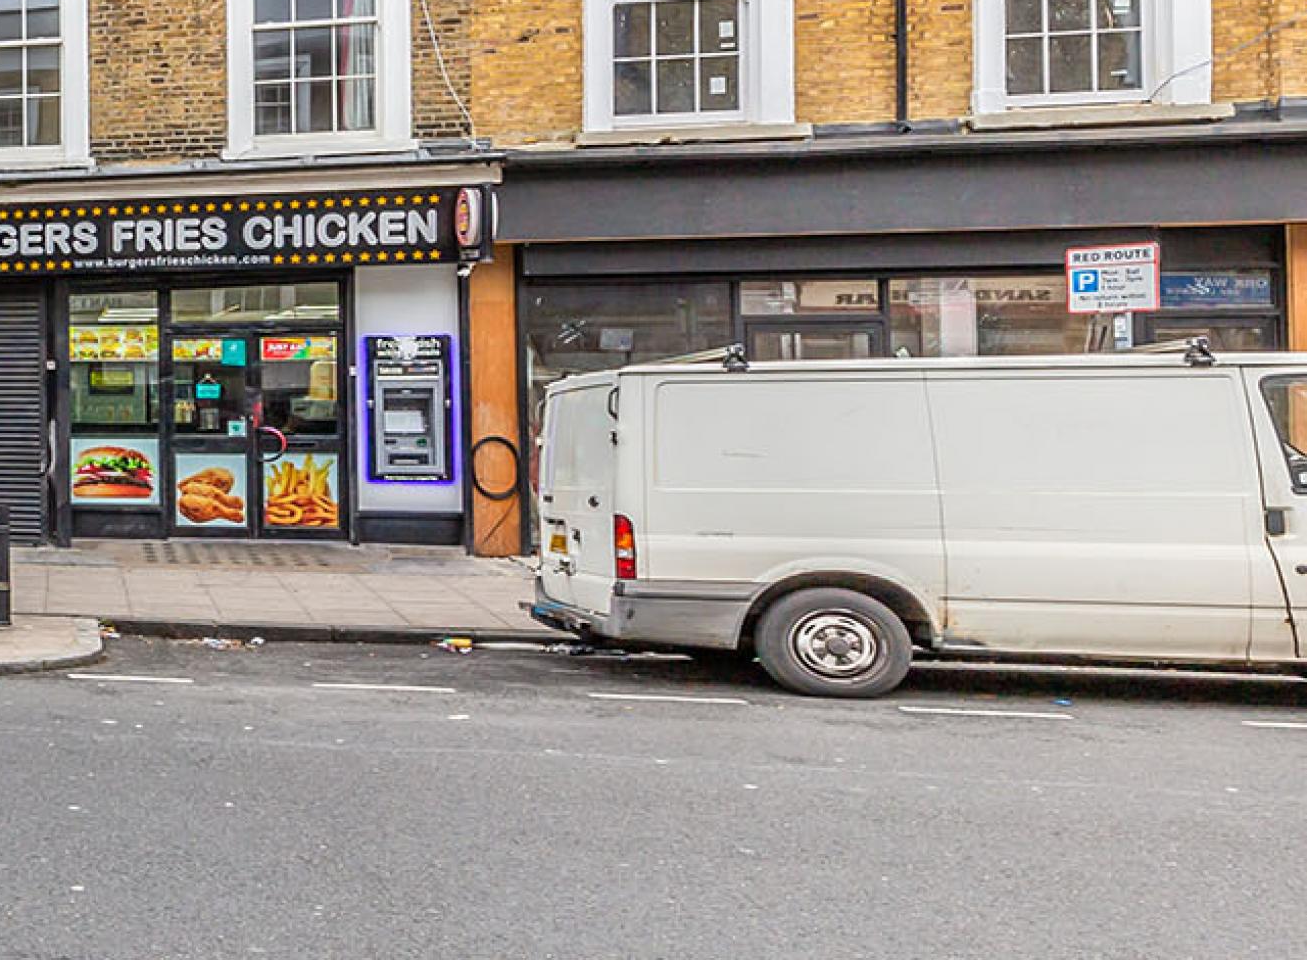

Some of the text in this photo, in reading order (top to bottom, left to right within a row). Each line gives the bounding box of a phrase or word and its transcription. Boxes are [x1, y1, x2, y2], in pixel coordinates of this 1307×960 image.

[112, 217, 227, 253] FRIES
[242, 209, 438, 248] CHICKEN
[73, 253, 272, 270] www.burgersfrieschicken.com
[1073, 248, 1151, 262] RED ROUTE
[1079, 273, 1096, 290] P
